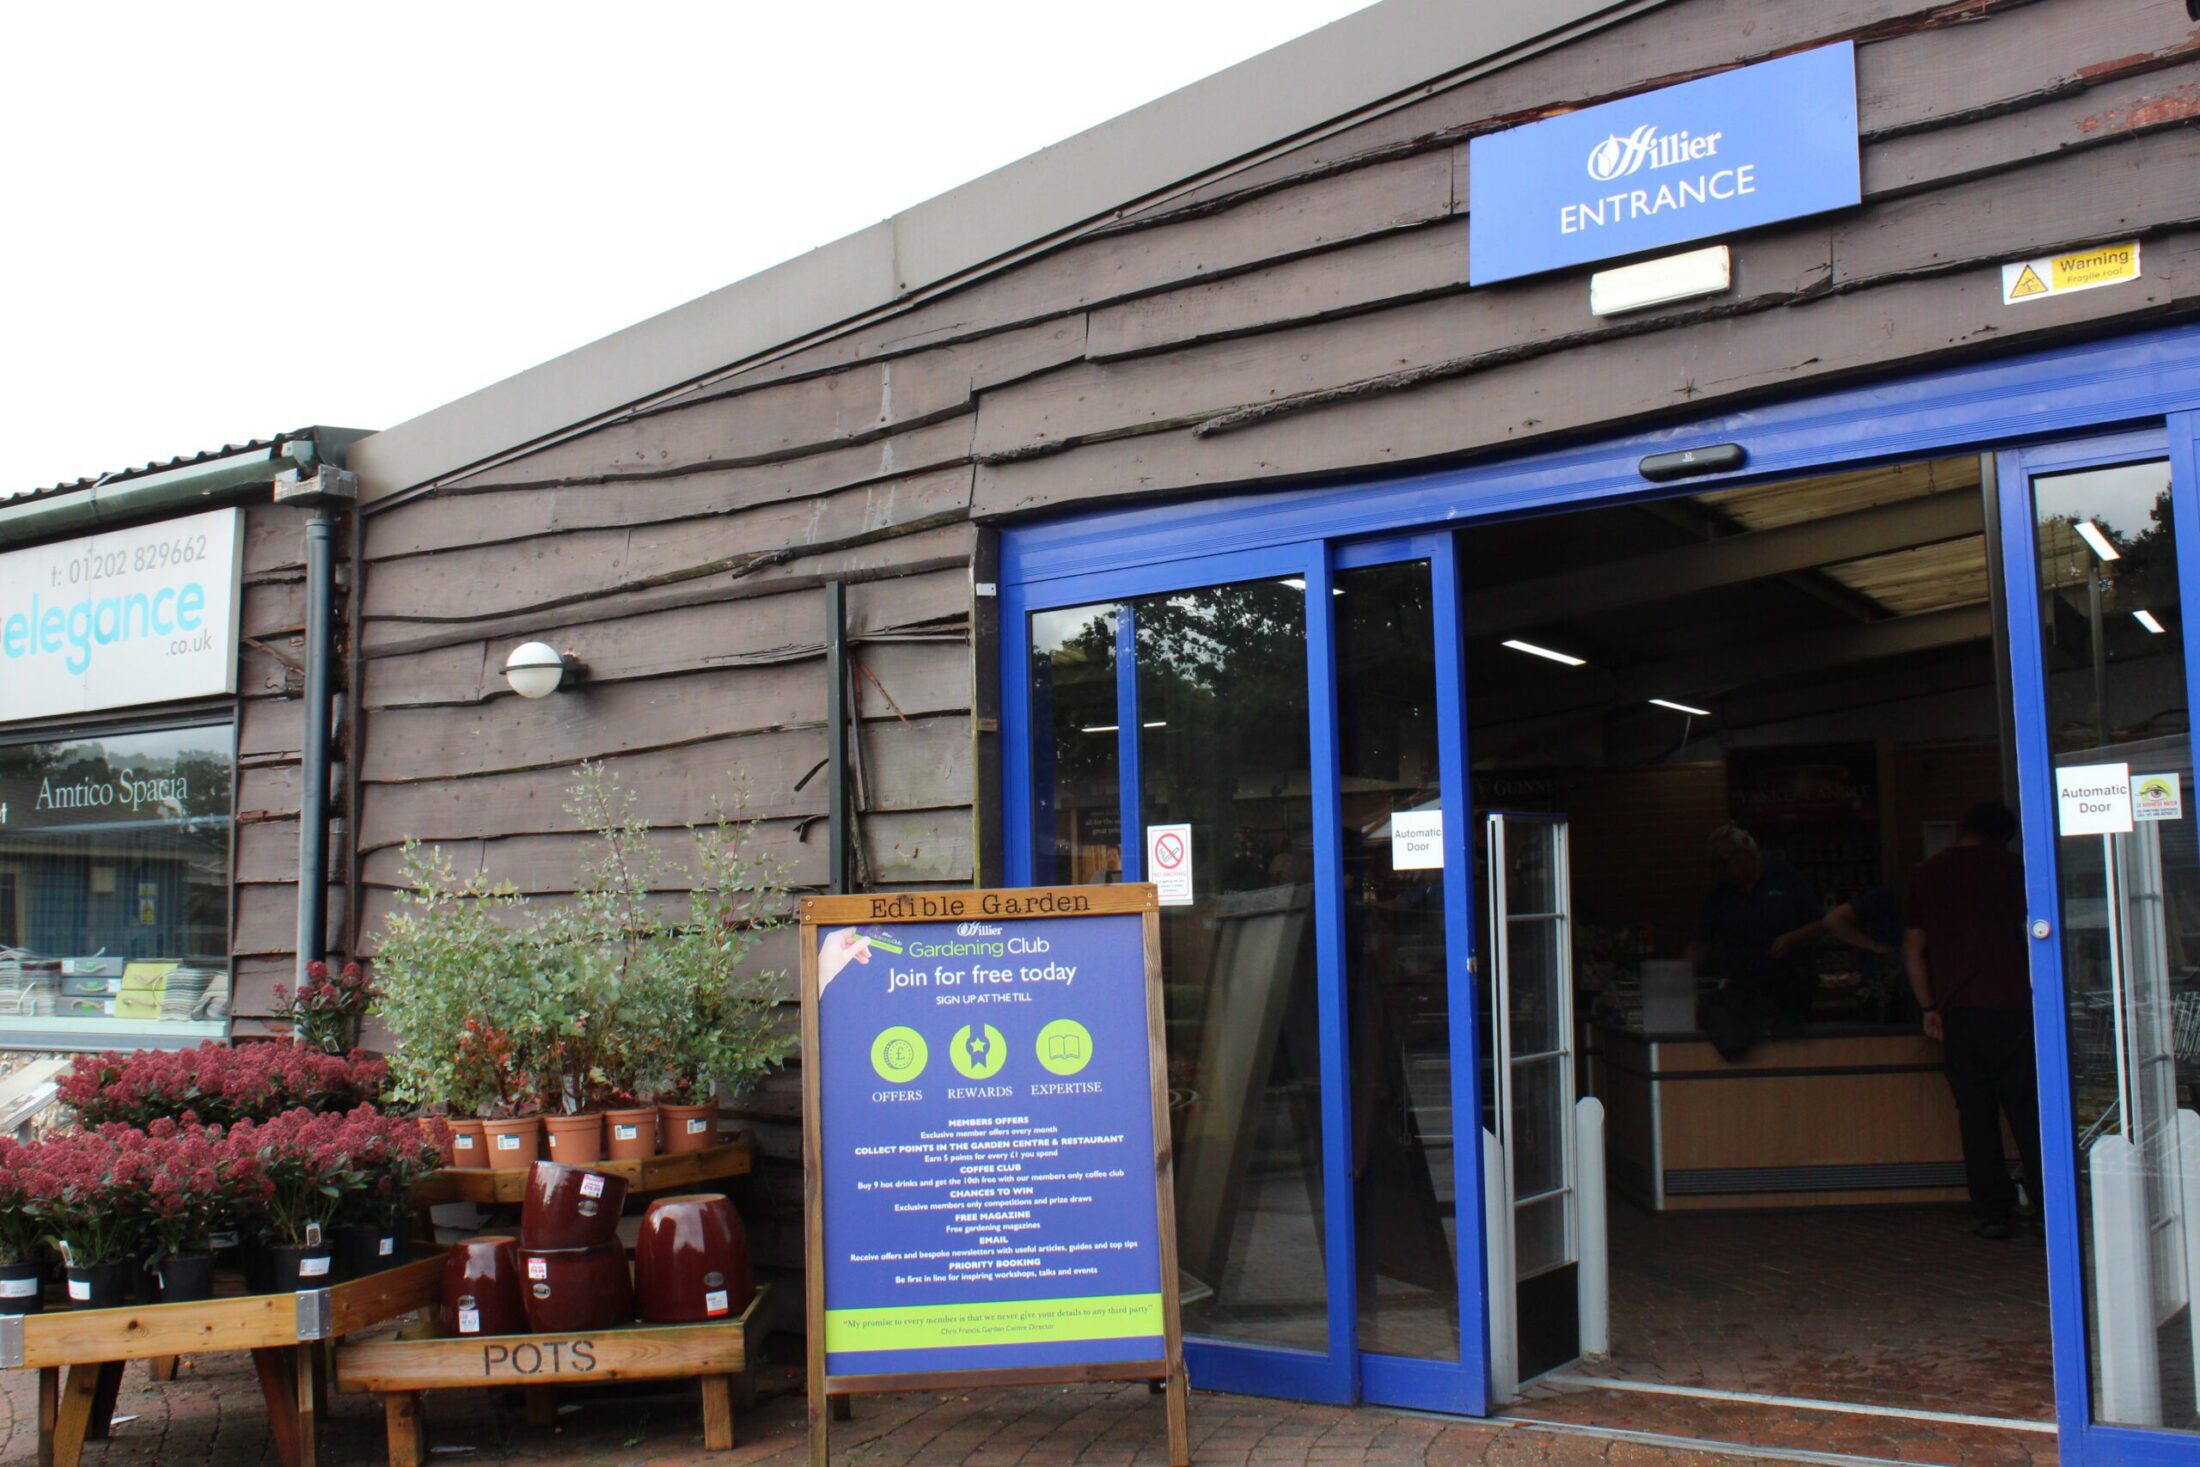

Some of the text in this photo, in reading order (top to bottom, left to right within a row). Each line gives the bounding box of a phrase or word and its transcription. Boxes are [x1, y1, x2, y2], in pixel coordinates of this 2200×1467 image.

[1587, 124, 1722, 181] Hillier
[1561, 165, 1755, 234] ENTRANCE
[2060, 251, 2129, 272] Warning
[2067, 266, 2123, 284] Fragile roof
[69, 550, 127, 584] 01202
[134, 535, 207, 572] 829662
[165, 629, 212, 656] .co.uk
[36, 768, 188, 811] Amtico Spacia
[2061, 784, 2128, 799] Automatic
[2079, 802, 2112, 814] Door
[1394, 828, 1441, 838] Automatic
[1407, 842, 1430, 852] Door
[870, 893, 1091, 918] Edible Garden
[957, 921, 1003, 936] Hillier
[909, 936, 1050, 958] Gardening Club
[888, 961, 1077, 993] Join for free today
[936, 991, 1033, 1005] SIGN UP AT THE TILL
[872, 1081, 1103, 1102] OFFERS REWARDS EXPERTISE
[948, 1116, 1029, 1127] MEMBERS OFFERS
[920, 1126, 1058, 1139] Exclusive member offers every month
[854, 1146, 896, 1155] COLLECT
[898, 1144, 934, 1153] POINTS
[936, 1143, 947, 1151] IN
[949, 1142, 968, 1150] THE
[970, 1141, 1010, 1150] GARDEN
[1012, 1138, 1050, 1147] CENTRE
[1061, 1135, 1124, 1145] RESTAURANT
[924, 1154, 942, 1163] Earn
[943, 1153, 948, 1162] 5
[949, 1153, 973, 1163] points
[974, 1152, 985, 1160] for
[1020, 1152, 1035, 1160] you
[1036, 1148, 1058, 1158] spend
[959, 1163, 1021, 1174] COFFEE CLUB
[857, 1181, 872, 1191] Buy
[894, 1179, 918, 1188] drinks
[919, 1178, 934, 1187] and
[934, 1179, 947, 1188] get
[963, 1176, 980, 1184] 10th
[998, 1174, 1014, 1183] with
[1030, 1172, 1066, 1181] members
[1066, 1171, 1083, 1180] only
[1084, 1170, 1107, 1178] coffee
[1108, 1169, 1124, 1177] club
[950, 1186, 1033, 1198] CHANCES TO WIN
[894, 1195, 1092, 1212] Exclusive members only competitions and prize draws
[954, 1210, 1030, 1221] FREE MAGAZINE
[945, 1225, 963, 1233] Free
[964, 1223, 1001, 1234] gardening
[979, 1236, 1008, 1244] EMAIL
[850, 1254, 879, 1262] Receive
[880, 1252, 902, 1260] offers
[903, 1251, 918, 1259] and
[918, 1249, 950, 1260] bespoke
[951, 1248, 995, 1257] newsletters
[996, 1246, 1013, 1254] with
[1014, 1245, 1036, 1254] useful
[1068, 1242, 1092, 1253] guides
[1093, 1241, 1108, 1250] and
[1109, 1242, 1122, 1250] top
[1124, 1240, 1138, 1249] tips
[949, 1258, 1040, 1270] PRIORITY BOOKING
[895, 1276, 905, 1284] Be
[907, 1275, 922, 1283] first
[932, 1274, 946, 1282] line
[947, 1273, 959, 1281] for
[960, 1272, 993, 1282] inspiring
[1038, 1268, 1056, 1277] talks
[1057, 1267, 1072, 1276] and
[1073, 1267, 1098, 1275] events
[484, 1340, 597, 1376] POTS
